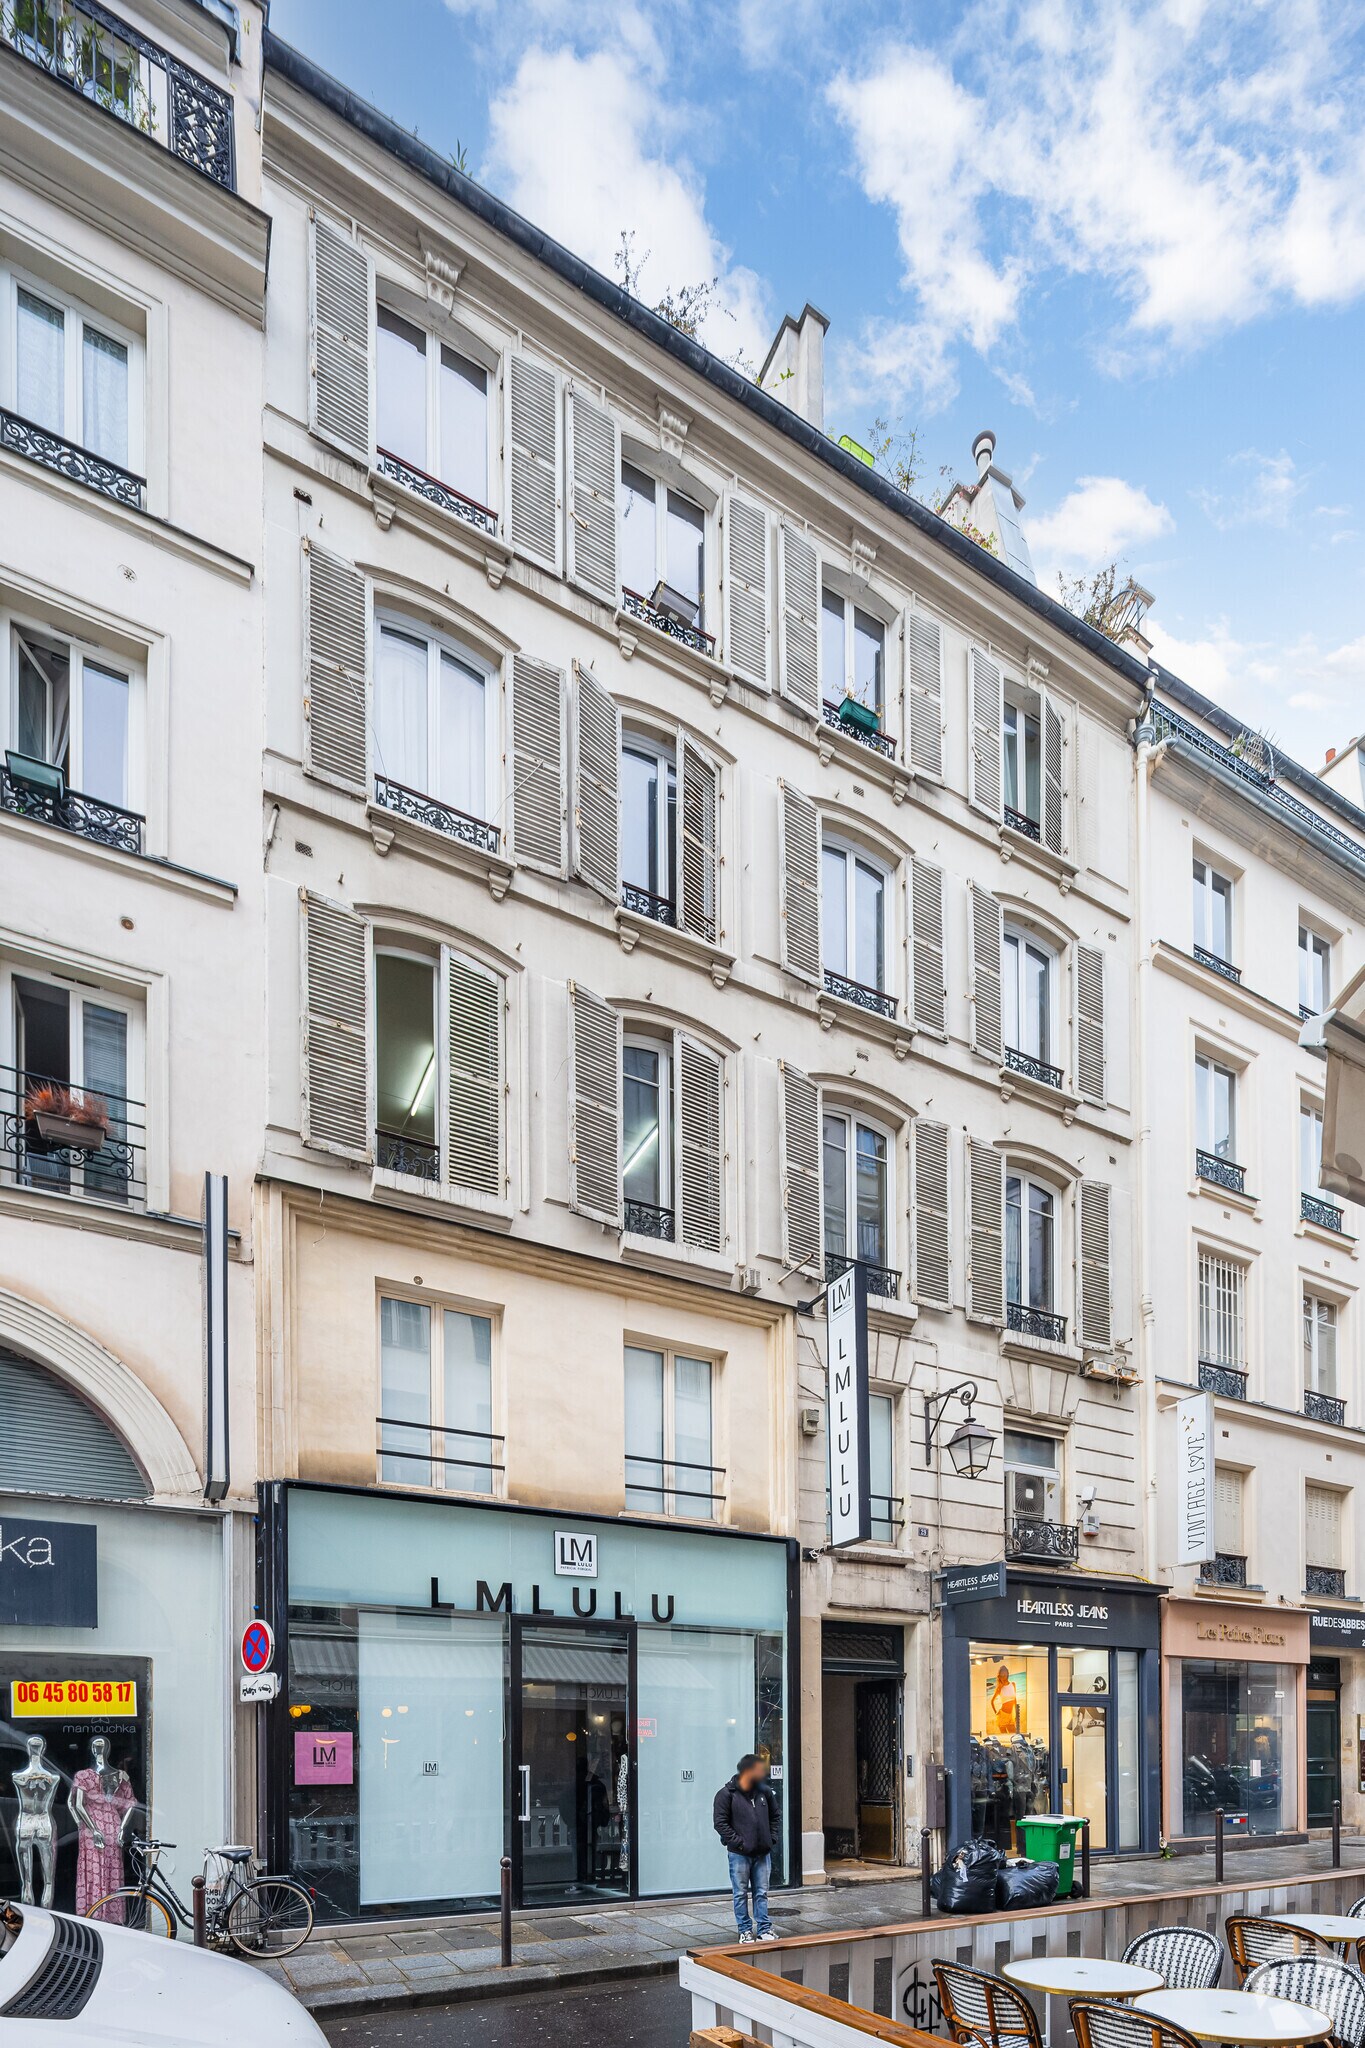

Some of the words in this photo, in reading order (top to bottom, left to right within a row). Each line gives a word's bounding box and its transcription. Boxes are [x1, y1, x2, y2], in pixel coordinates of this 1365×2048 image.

[833, 1278, 850, 1312] LM
[1187, 1477, 1206, 1550] VINTAGE
[560, 1537, 592, 1566] LM
[947, 1576, 978, 1589] HEARTLESS
[979, 1572, 999, 1584] JEANS
[1017, 1599, 1074, 1617] HEARTLESS
[1076, 1604, 1109, 1620] JEANS
[1196, 1622, 1217, 1641] Les
[1219, 1624, 1251, 1643] Petites
[1253, 1627, 1286, 1646] Fleurs
[17, 1683, 39, 1703] 06
[43, 1683, 64, 1703] 45
[67, 1683, 89, 1703] 80
[92, 1683, 113, 1703] 58
[115, 1683, 131, 1702] 17
[313, 1747, 336, 1765] LM
[425, 1762, 437, 1773] LM
[682, 1770, 693, 1780] LM
[772, 1767, 782, 1777] LM
